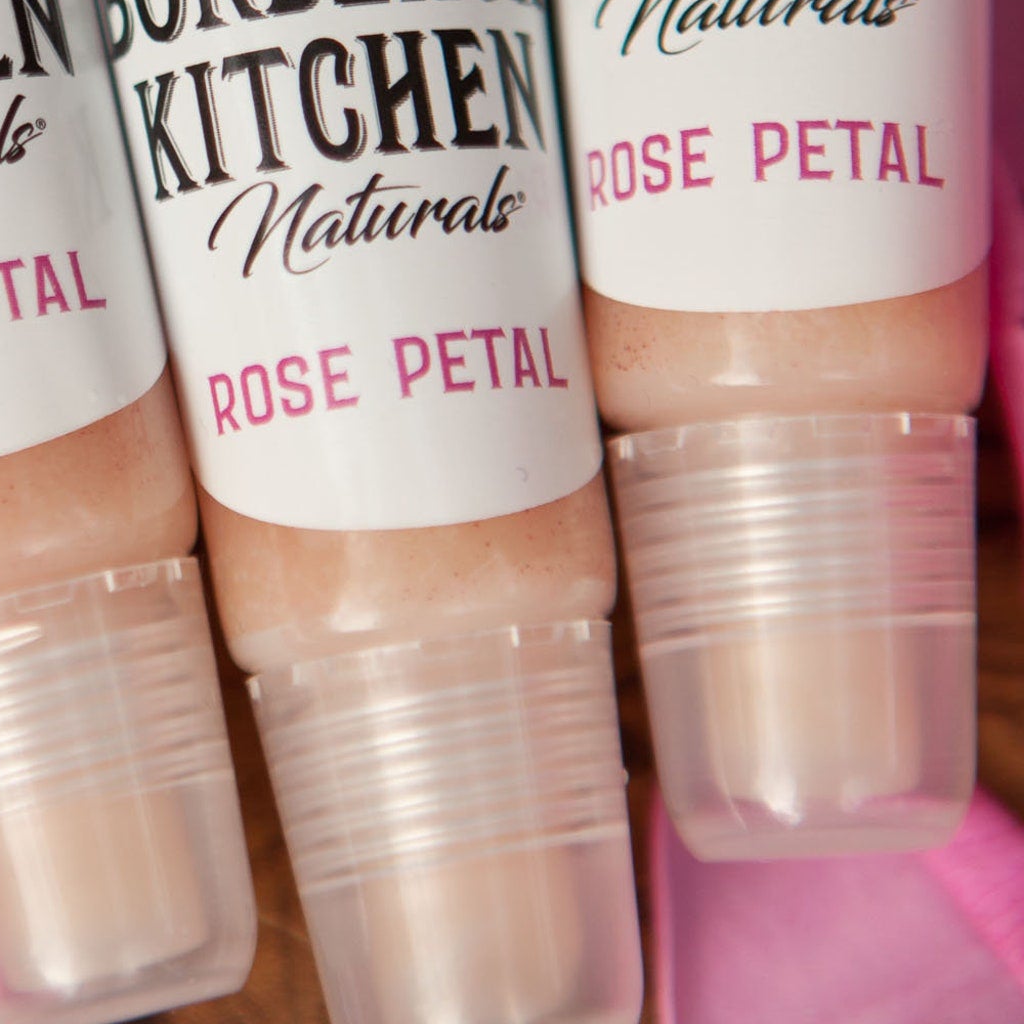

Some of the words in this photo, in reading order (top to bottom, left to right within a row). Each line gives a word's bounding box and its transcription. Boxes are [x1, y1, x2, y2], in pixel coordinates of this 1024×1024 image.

[134, 27, 546, 203] KITCHEN
[587, 124, 714, 212] ROSE
[752, 119, 945, 189] PETAL
[208, 346, 359, 436] ROSE
[392, 327, 569, 399] PETAL
